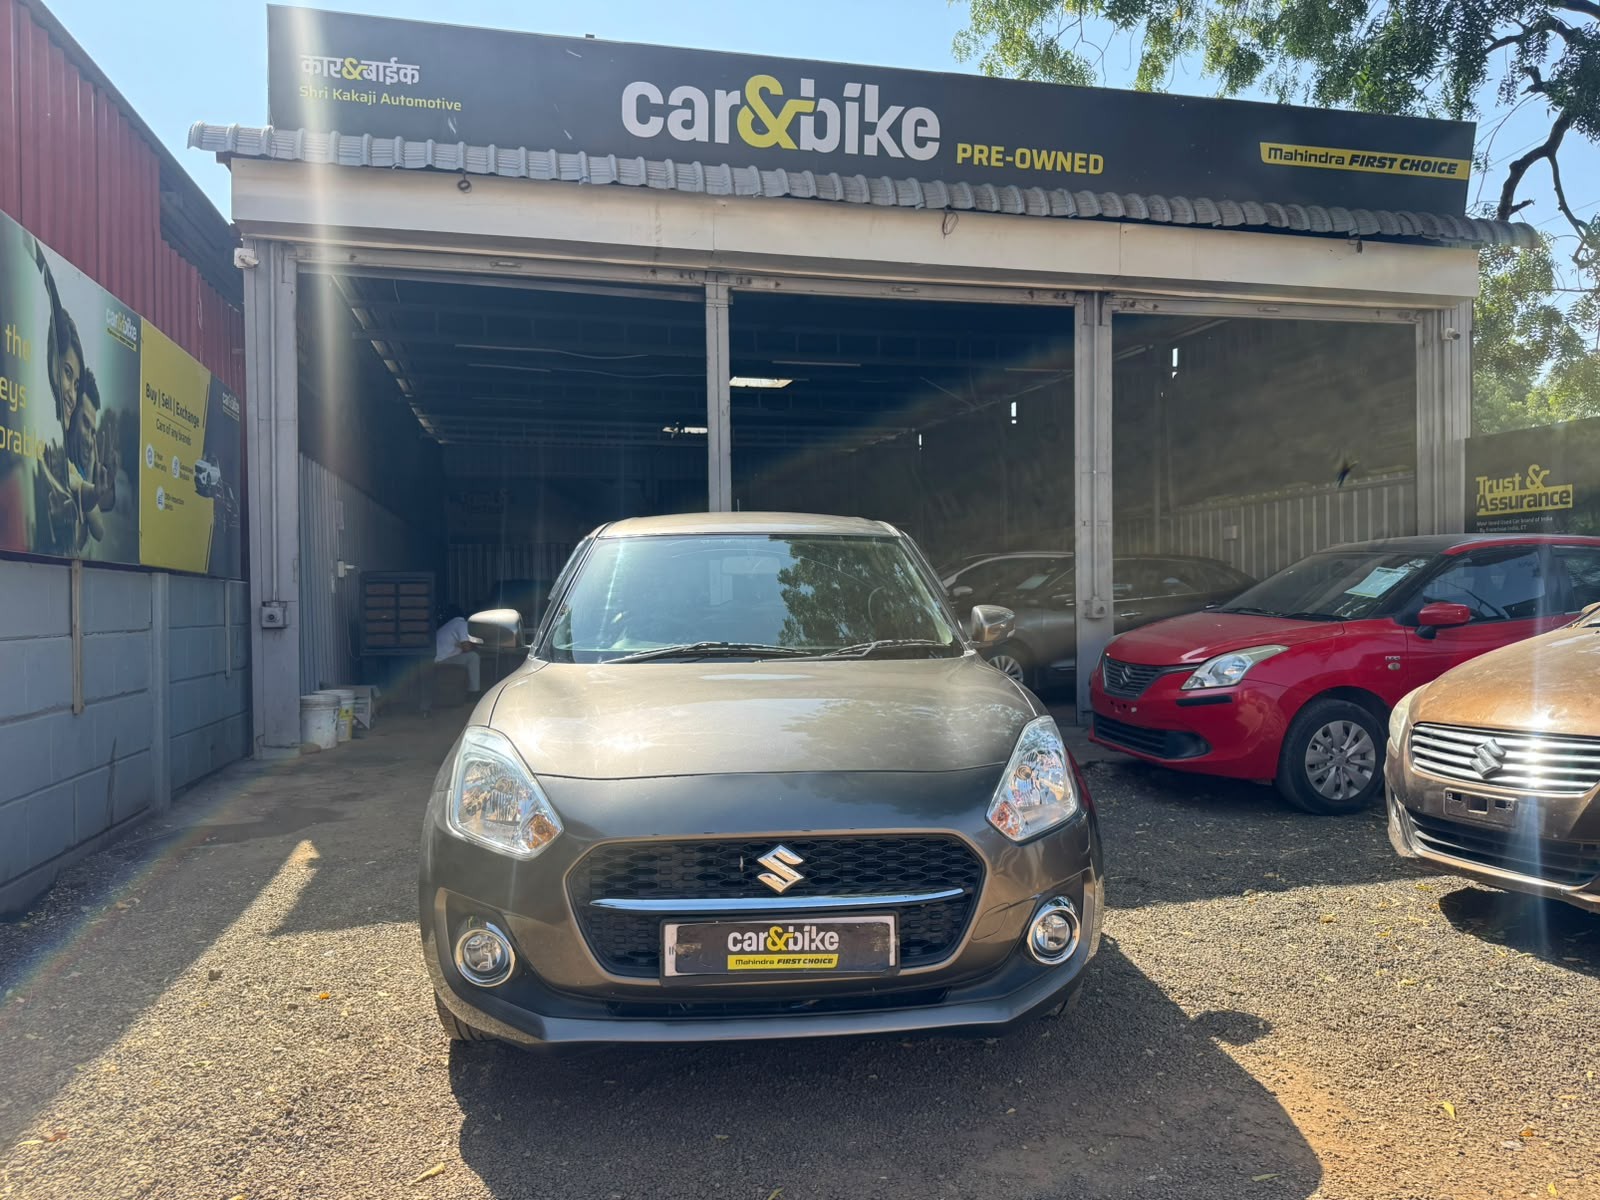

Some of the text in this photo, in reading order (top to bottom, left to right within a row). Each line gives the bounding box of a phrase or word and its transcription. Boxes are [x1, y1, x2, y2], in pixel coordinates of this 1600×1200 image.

[299, 85, 463, 111] Shri Kakaji Automotive
[621, 74, 941, 161] car&bike
[956, 142, 1105, 175] PRE-OWNED
[1267, 146, 1459, 175] Mahindra FIRST CHOICE
[5, 323, 31, 361] the
[146, 382, 157, 405] Buy
[161, 392, 172, 411] Sell
[176, 401, 200, 428] Exchange
[1476, 464, 1550, 496] Trust &
[1477, 489, 1571, 512] Assurance
[727, 926, 839, 952] car&bike
[735, 957, 834, 966] Mahindra FIRST CHOICE
